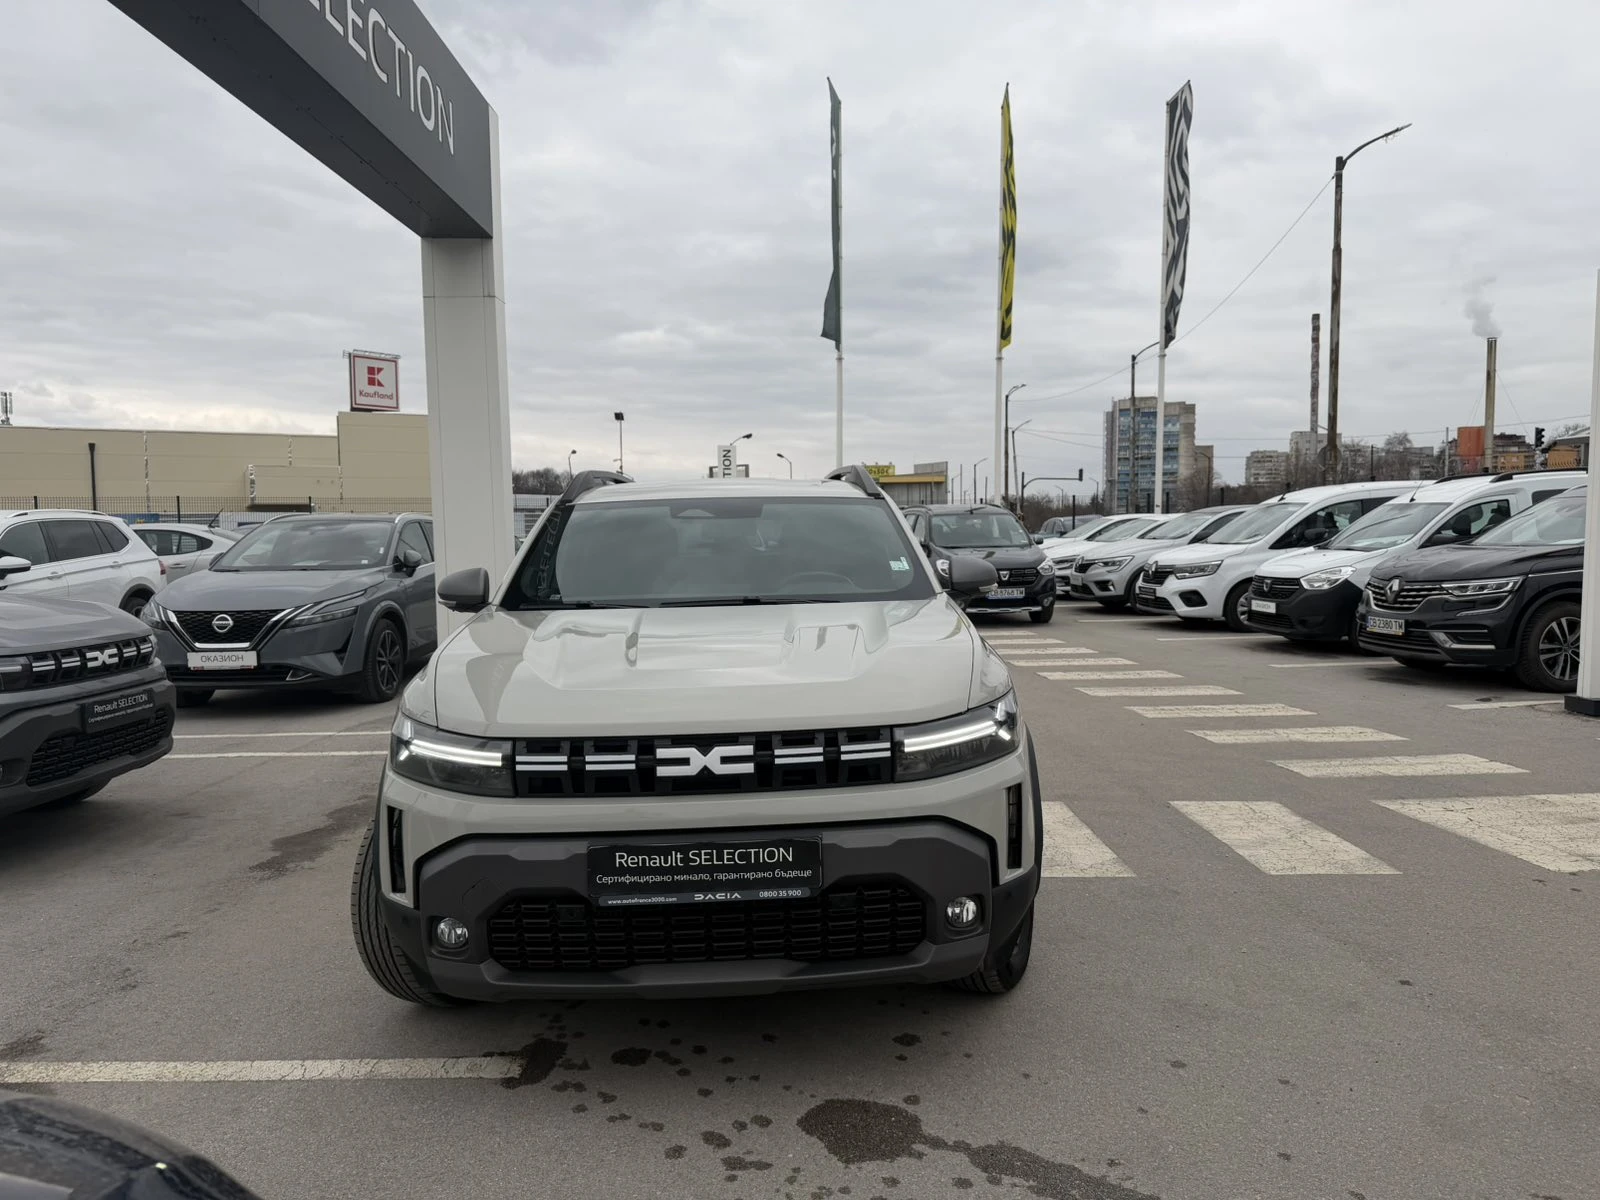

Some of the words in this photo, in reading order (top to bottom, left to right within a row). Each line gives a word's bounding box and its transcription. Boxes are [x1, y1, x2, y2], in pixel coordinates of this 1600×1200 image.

[308, 0, 454, 155] ECTION
[359, 390, 394, 400] Kaufland
[1377, 618, 1393, 629] 2380
[1393, 620, 1403, 630] TM
[201, 654, 244, 663] ОКАЗИОН
[94, 701, 118, 713] Renault
[118, 693, 149, 707] SELECTION
[615, 850, 684, 868] Renault
[688, 846, 793, 866] SELECTION
[596, 873, 672, 885] Сертифицирано
[674, 872, 711, 882] минало,
[713, 870, 773, 882] гарантирано
[774, 868, 813, 878] бъдеще
[694, 892, 742, 901] DACIA
[759, 890, 778, 898] 0800
[787, 889, 802, 897] 900
